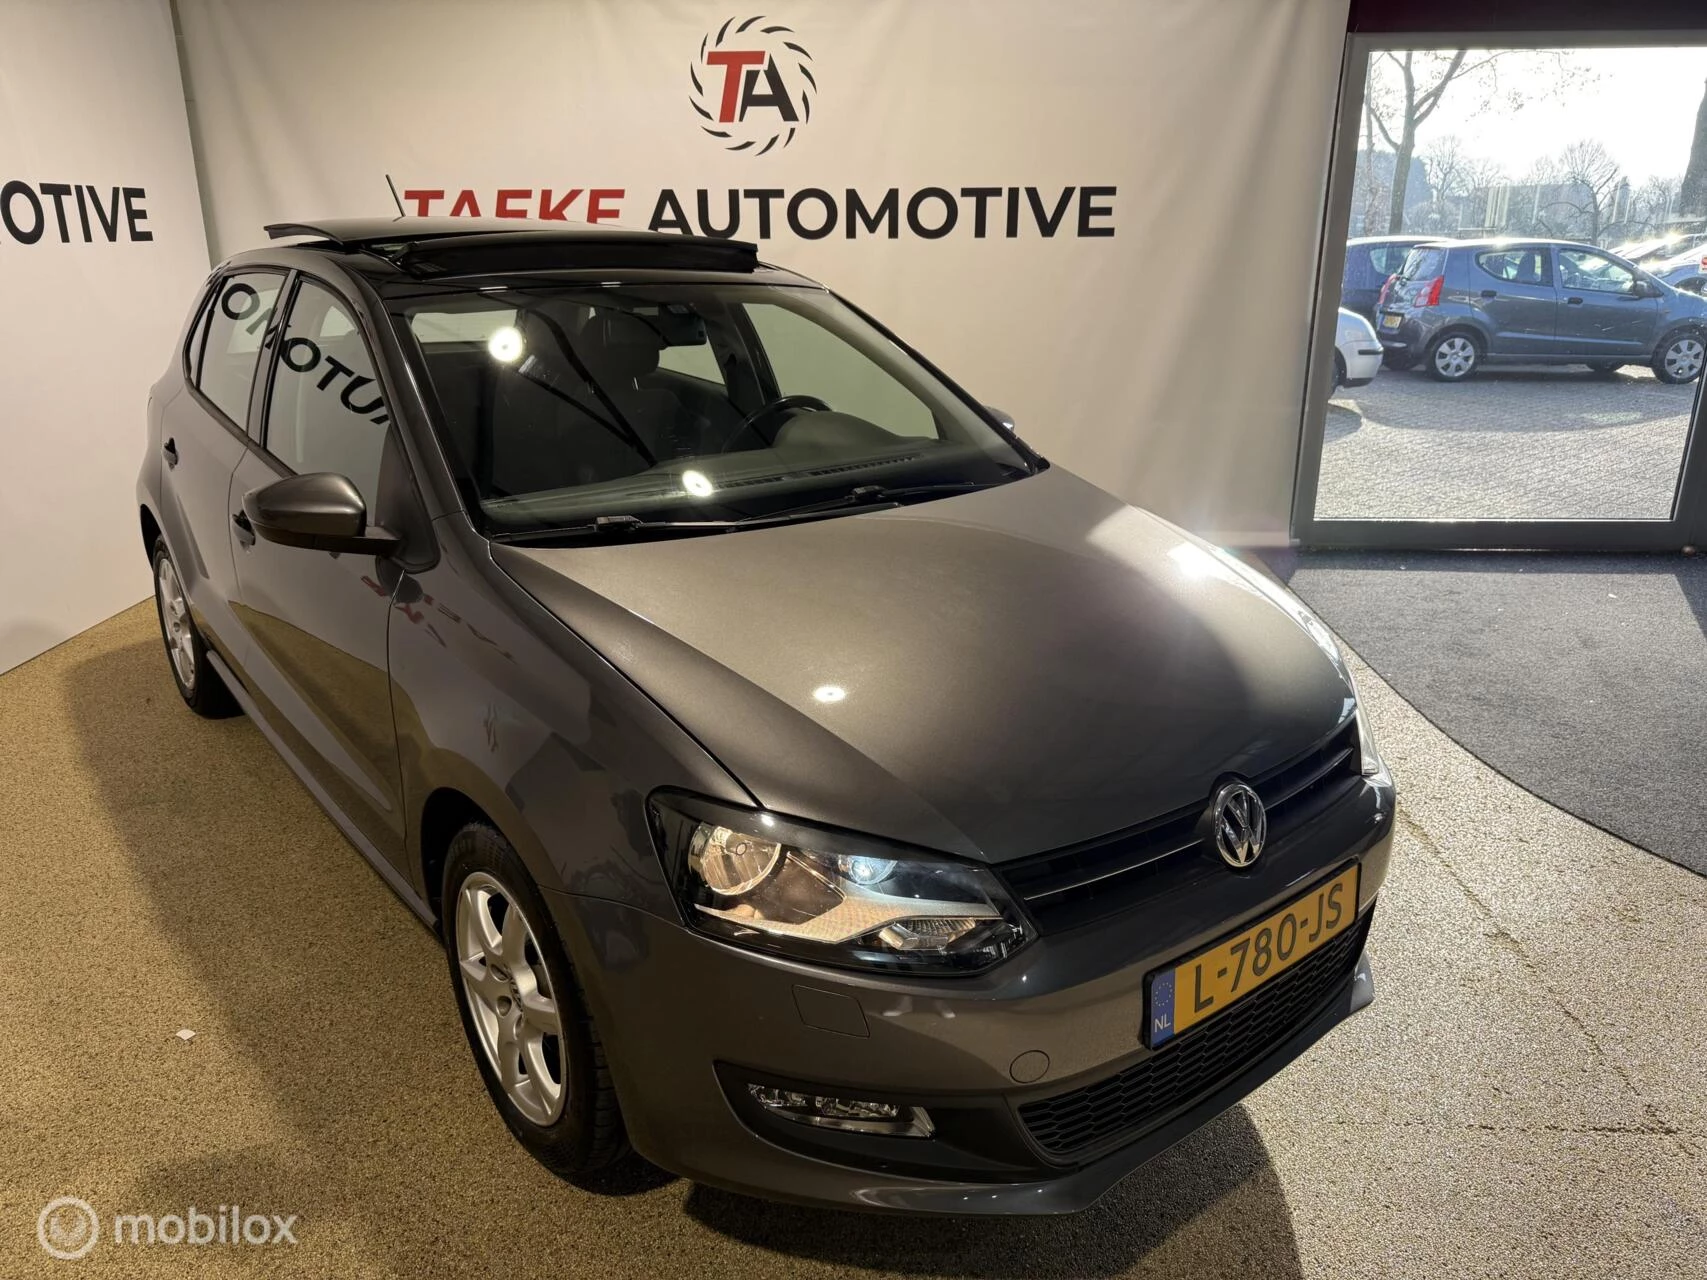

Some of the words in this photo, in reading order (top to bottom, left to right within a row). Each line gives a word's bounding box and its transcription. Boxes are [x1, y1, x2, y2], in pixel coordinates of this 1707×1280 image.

[706, 50, 800, 123] TA
[0, 179, 154, 245] OTIVE
[647, 186, 1117, 240] AUTOMOTIVE
[1193, 882, 1344, 1013] L-780-JS
[1153, 1014, 1172, 1034] NL
